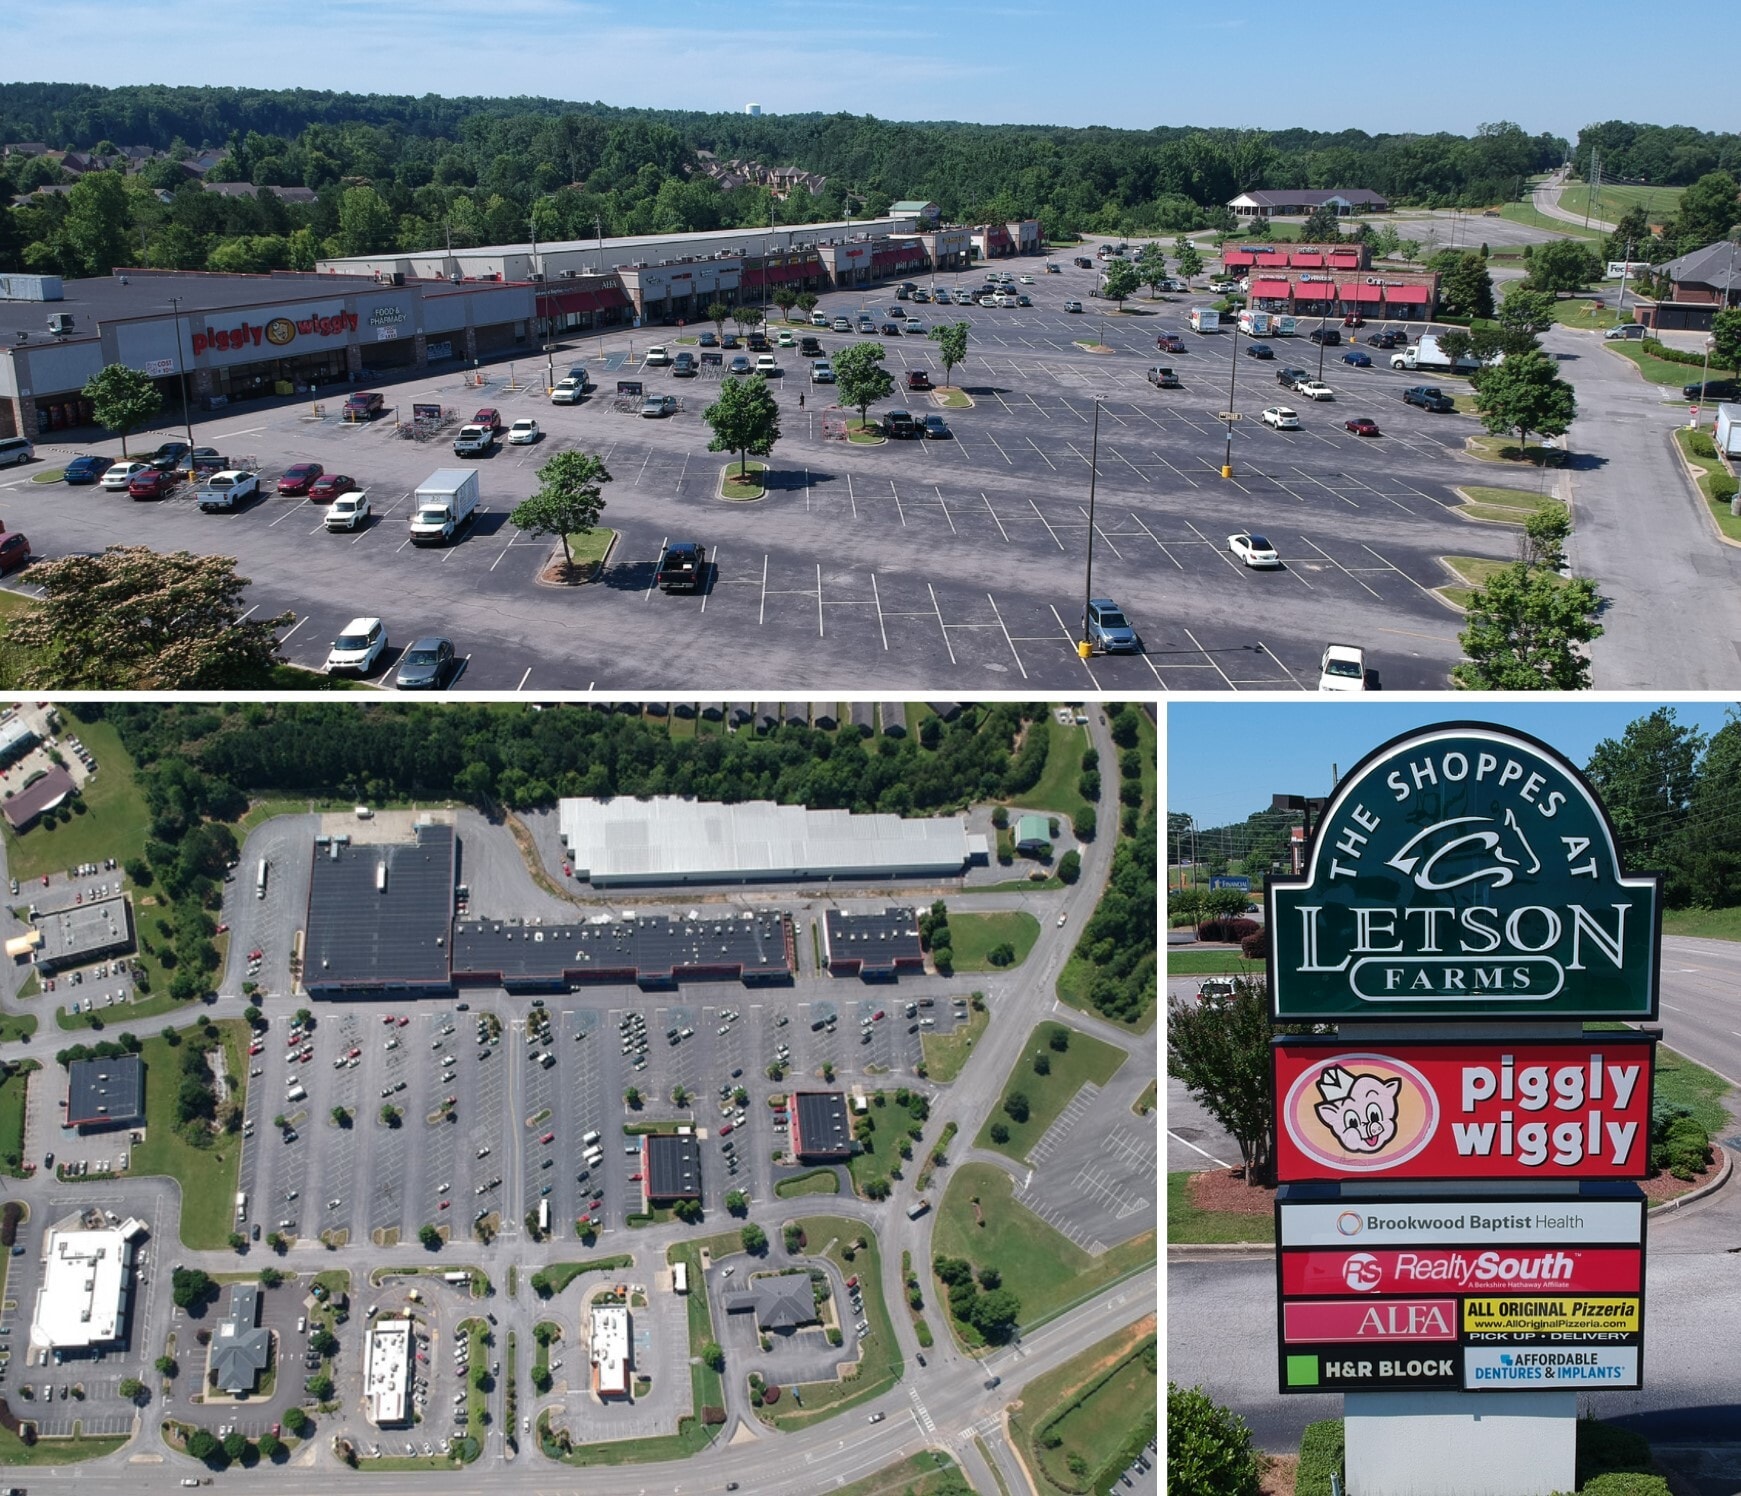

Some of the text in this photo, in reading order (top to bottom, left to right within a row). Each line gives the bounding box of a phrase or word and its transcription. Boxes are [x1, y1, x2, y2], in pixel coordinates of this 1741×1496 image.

[601, 279, 617, 289] ALFA
[370, 313, 407, 326] PHARMACY
[375, 307, 395, 316] FOOD
[192, 322, 263, 356] piggly
[296, 309, 359, 336] wiggly
[157, 359, 172, 367] COST
[1329, 751, 1598, 881] THE SHOPPES AT
[1294, 904, 1633, 972] LETSON
[1384, 966, 1533, 990] FARMS
[1462, 1053, 1640, 1112] piggly
[1451, 1109, 1638, 1167] wiggly
[1367, 1214, 1585, 1233] Brookwood Baptist Health
[1395, 1251, 1574, 1286] RealtySouth
[1508, 1281, 1542, 1289] Hathaway
[1467, 1301, 1635, 1316] ALL ORIGINAL Pizzeria
[1357, 1307, 1450, 1335] ALFA
[1474, 1319, 1627, 1331] www.AllOriginalPizzeria.com
[1470, 1332, 1630, 1340] PICK UP DELIVERY
[1515, 1353, 1598, 1366] AFFORDABLE
[1325, 1359, 1454, 1378] H&R BLOCK
[1476, 1366, 1622, 1380] DENTURES & IMPLANTS
